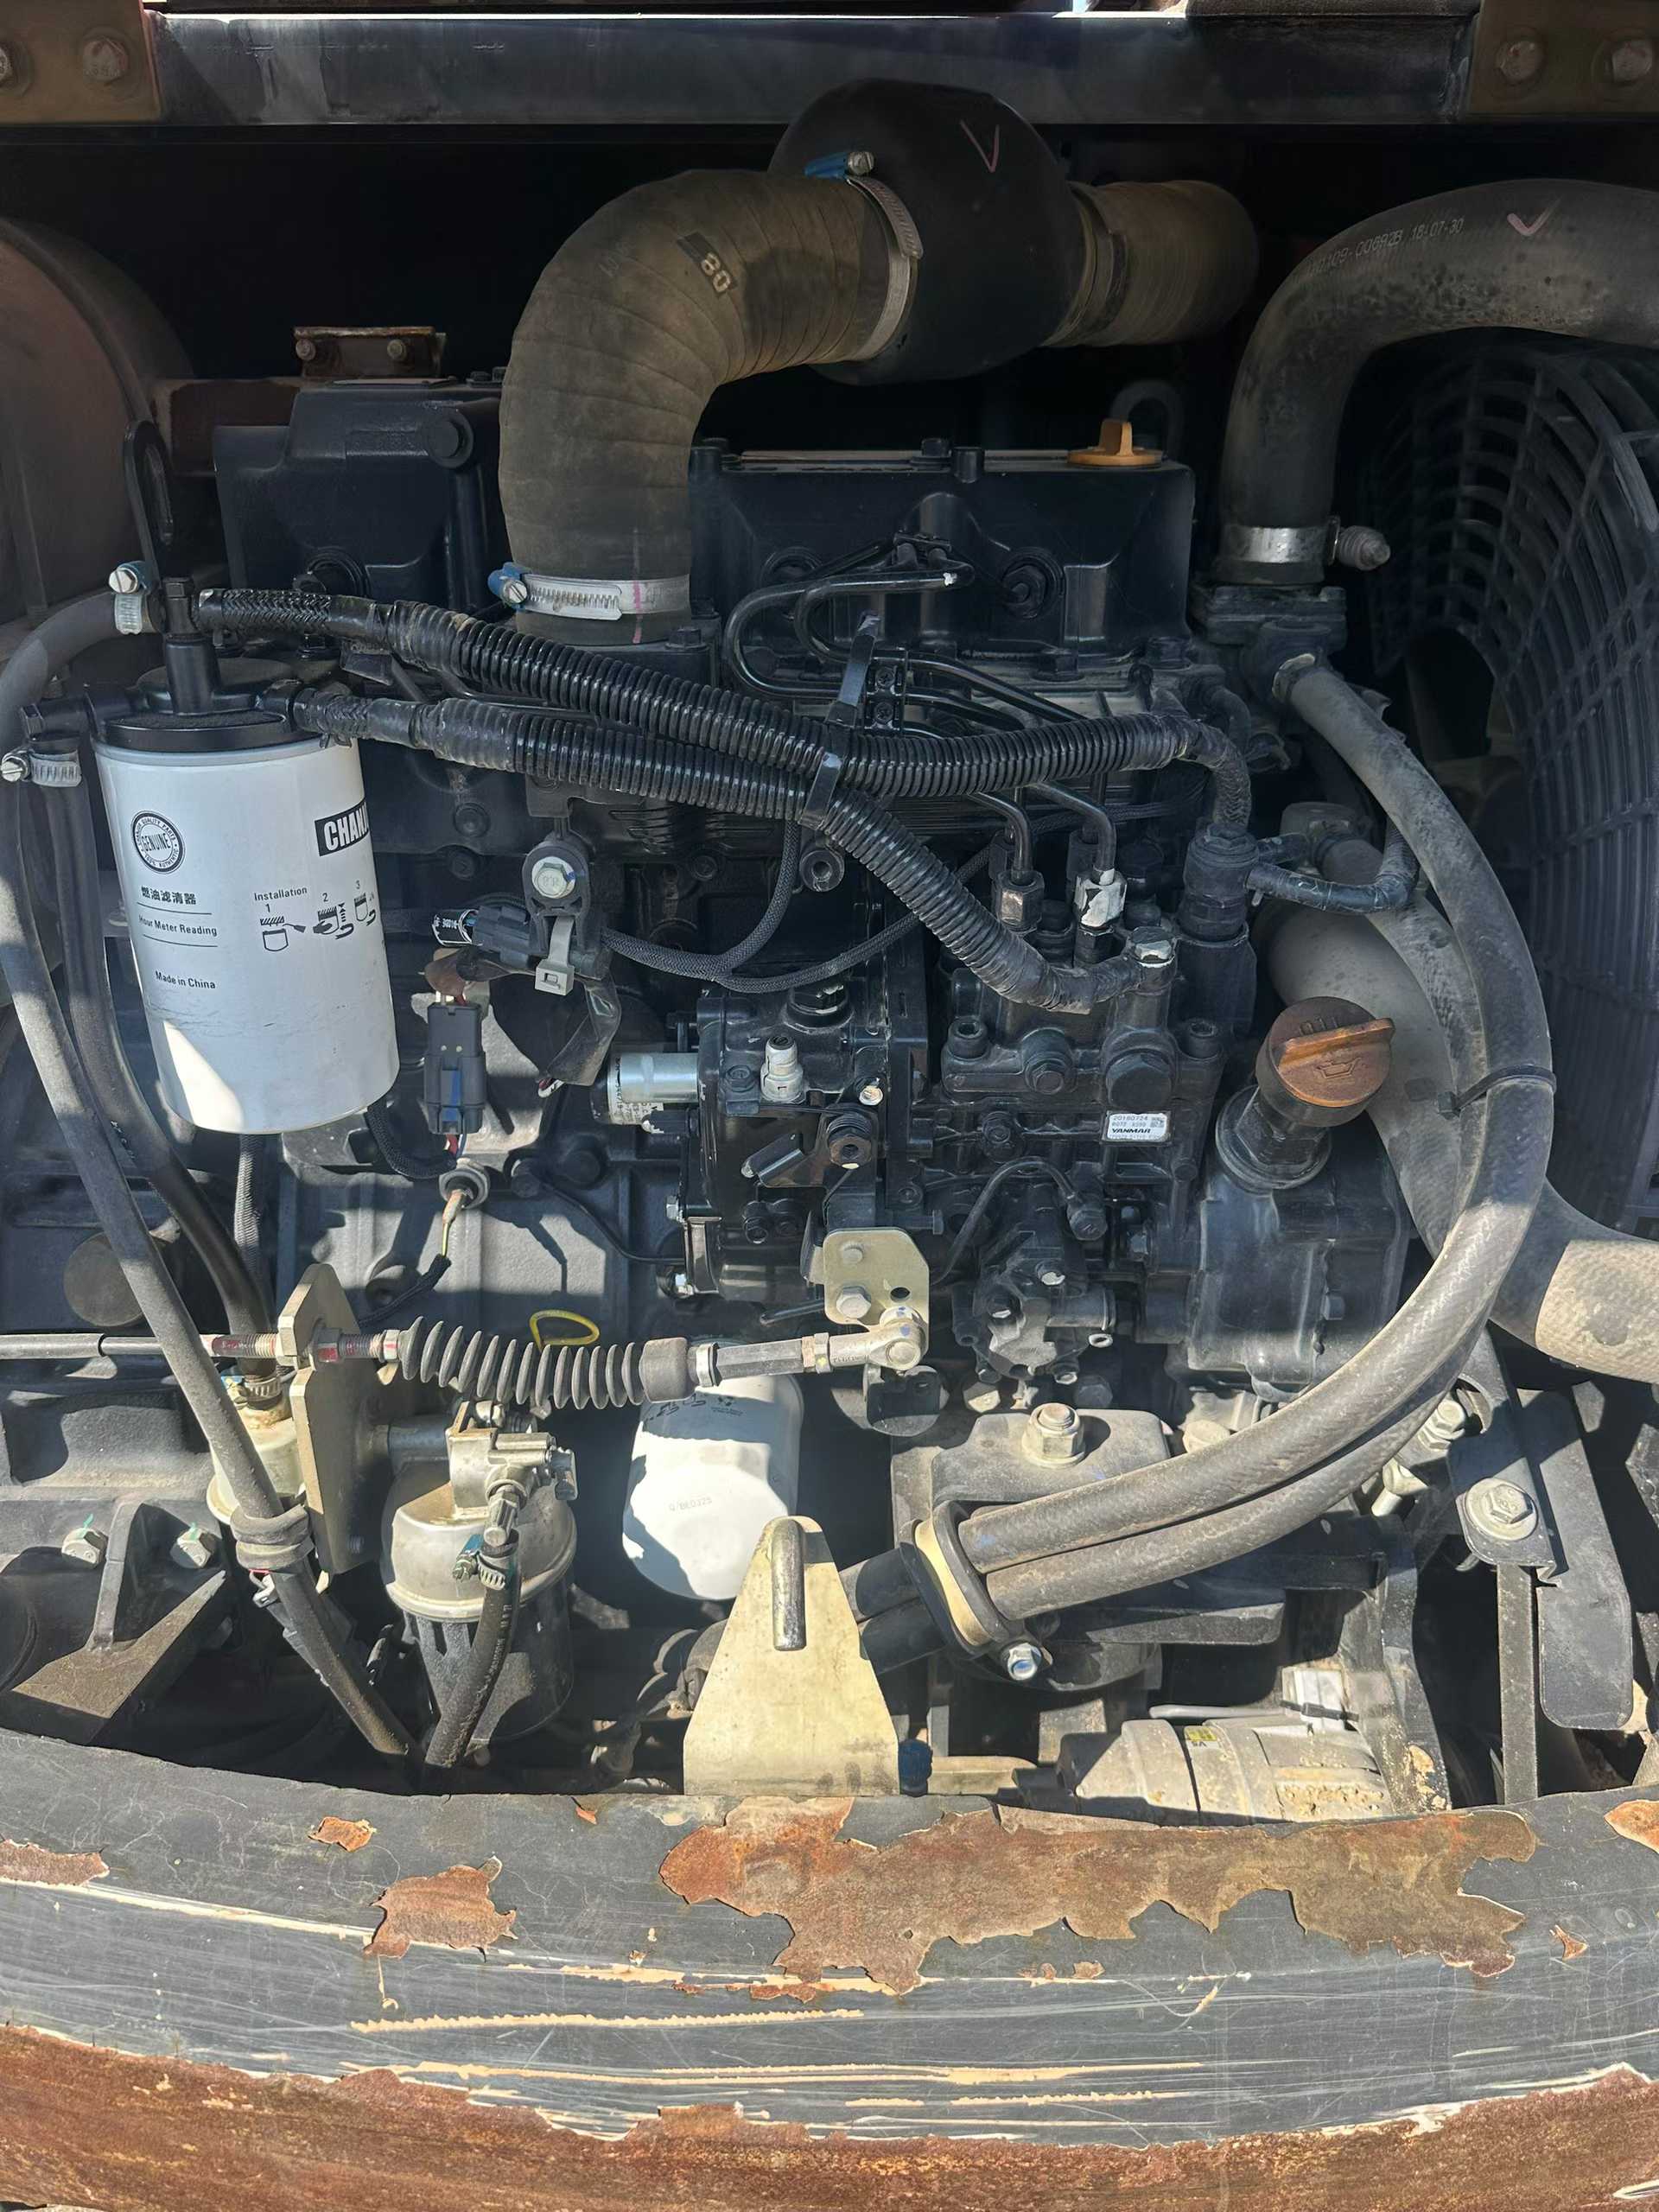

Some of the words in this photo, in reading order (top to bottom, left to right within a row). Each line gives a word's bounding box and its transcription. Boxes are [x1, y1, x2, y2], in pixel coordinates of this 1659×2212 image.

[355, 880, 361, 890] 3
[254, 887, 308, 902] Installation
[322, 893, 329, 902] 2
[265, 903, 271, 913] 1
[154, 918, 178, 932] Meter
[179, 924, 218, 938] Reading
[155, 970, 177, 984] Made
[178, 976, 187, 987] in
[188, 978, 217, 990] China
